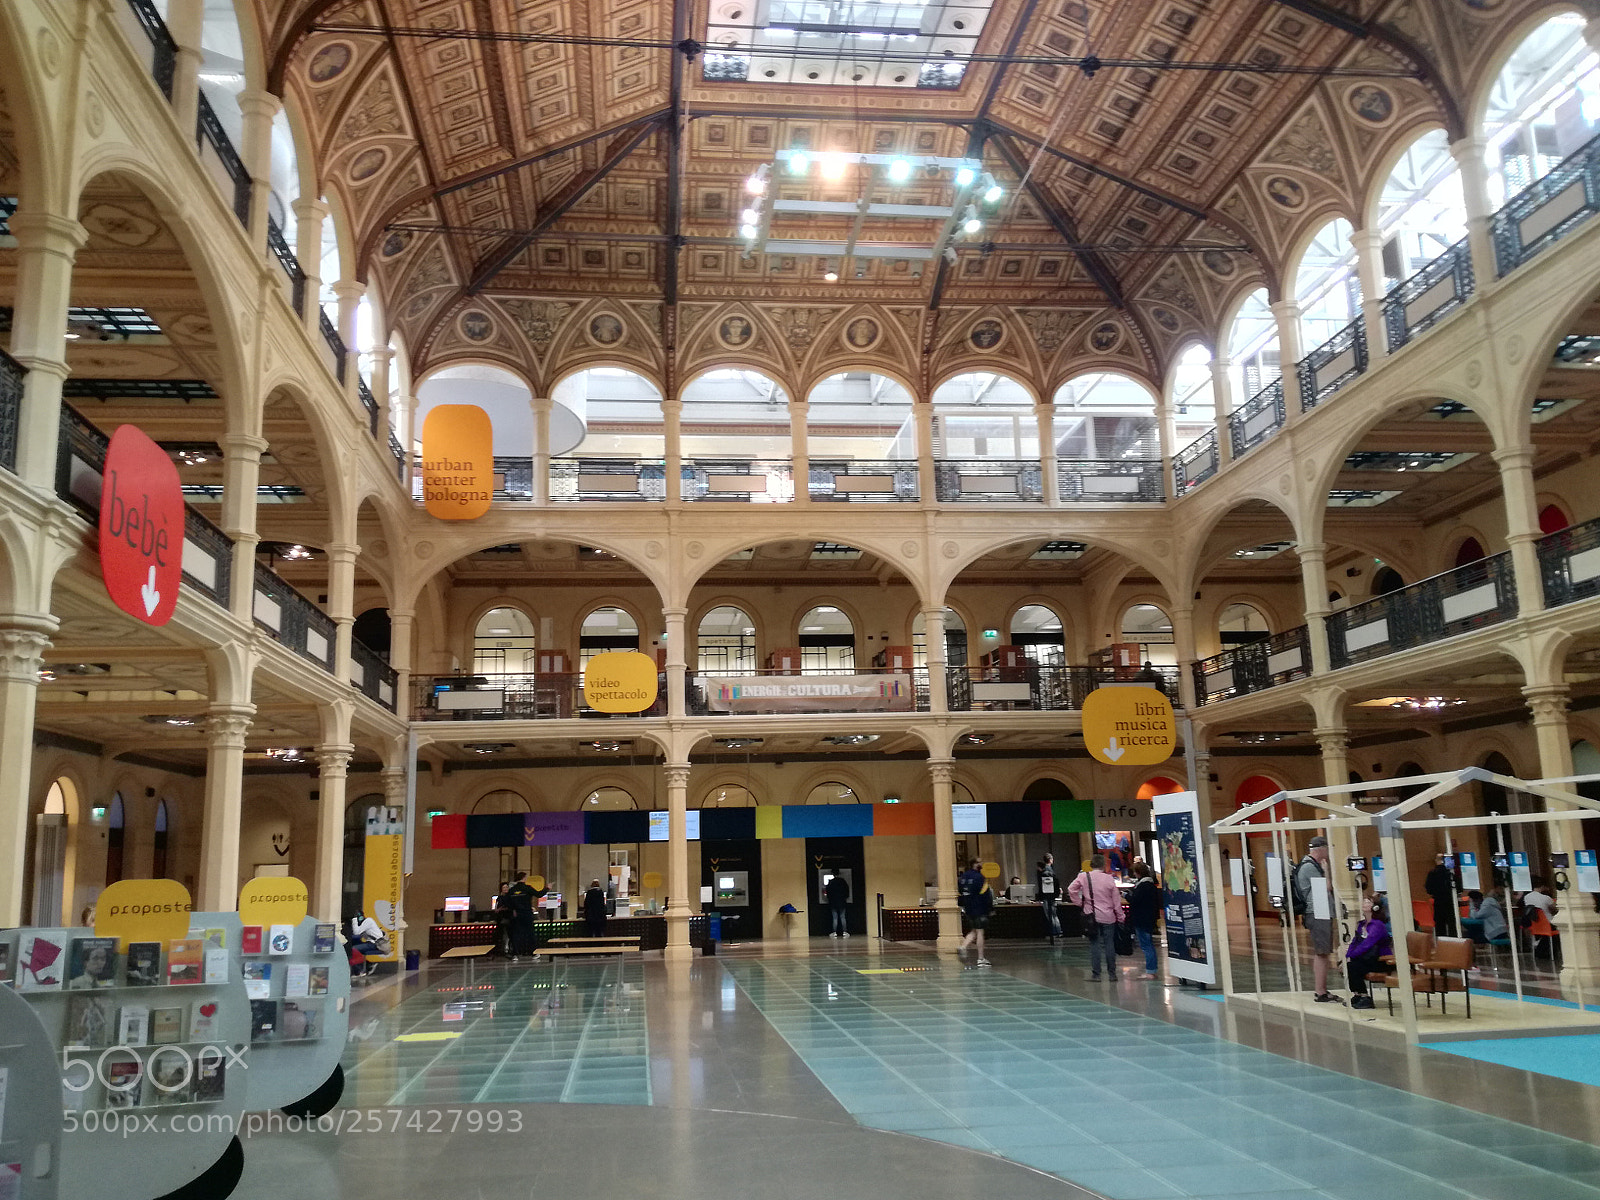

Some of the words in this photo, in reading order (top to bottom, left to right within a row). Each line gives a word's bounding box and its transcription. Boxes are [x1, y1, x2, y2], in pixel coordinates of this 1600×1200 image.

[425, 457, 473, 471] urban
[425, 475, 477, 486] center
[425, 487, 490, 506] bologna
[109, 469, 168, 568] bebè
[705, 637, 748, 645] spettacoo
[589, 677, 621, 688] video
[589, 688, 648, 703] spettacolo
[741, 684, 781, 697] ENERGIE
[787, 683, 852, 697] CULTURA
[1135, 702, 1167, 716] libri
[1115, 718, 1168, 731] musica
[1119, 732, 1170, 746] ricerca
[1098, 805, 1138, 818] info
[250, 893, 310, 905] proposte
[110, 901, 193, 917] proposte
